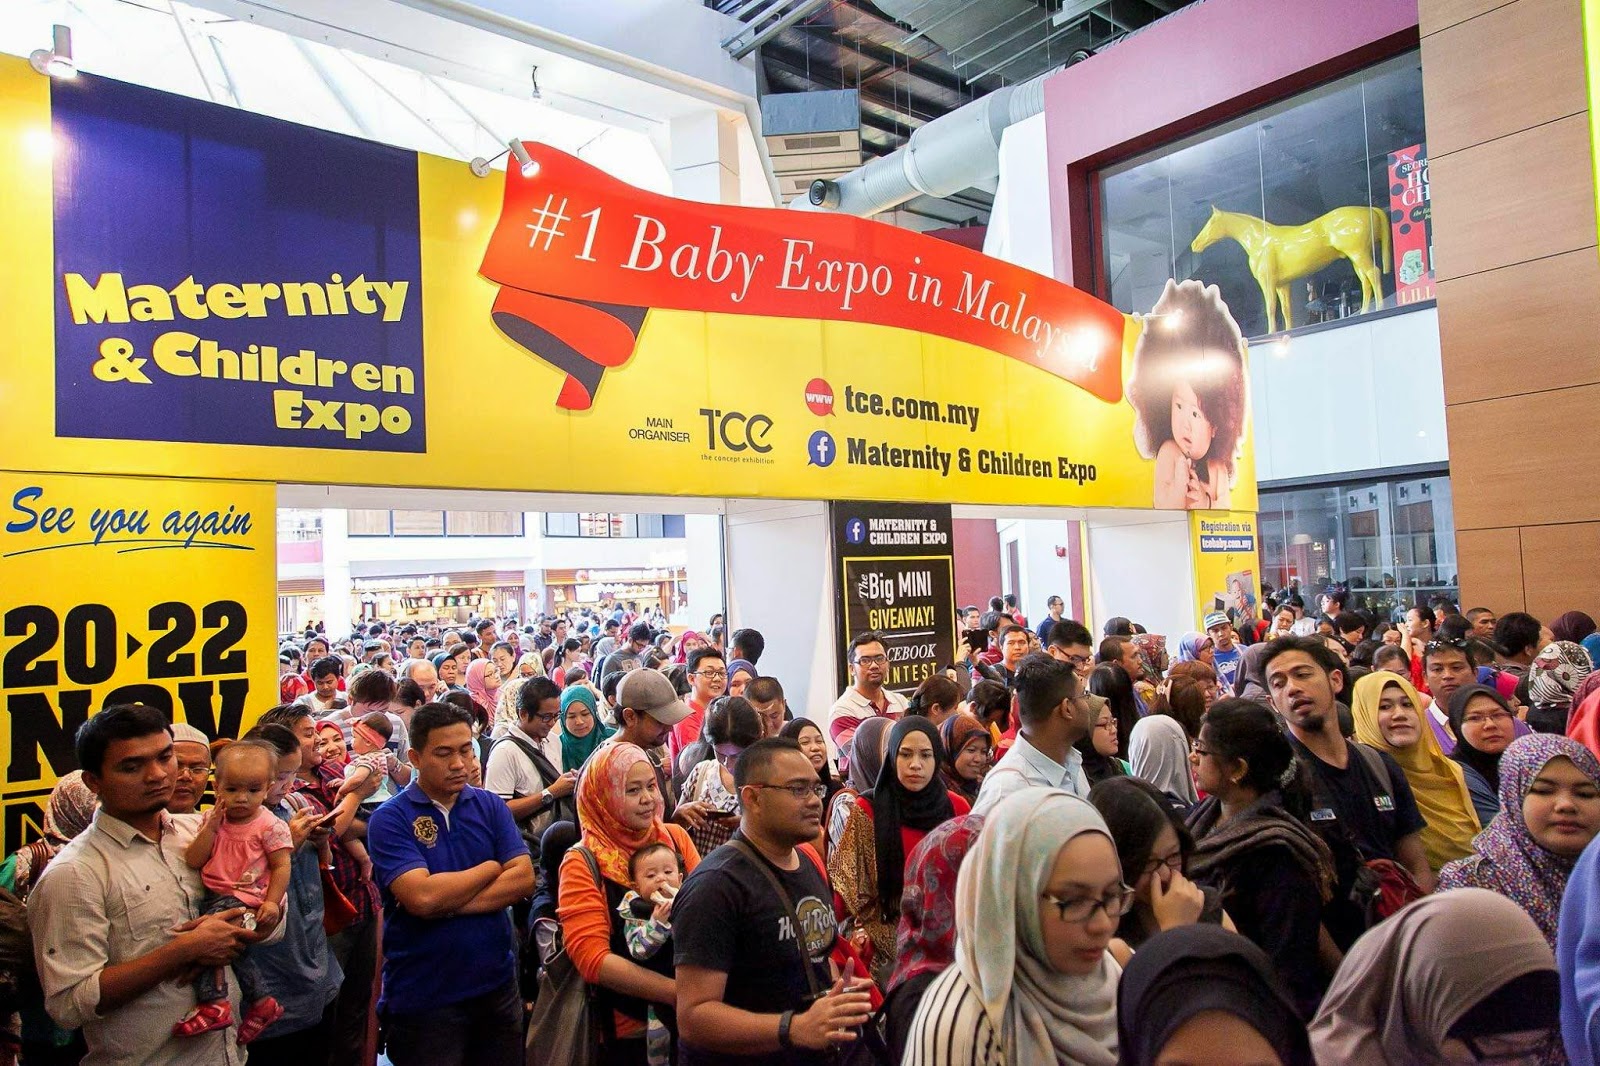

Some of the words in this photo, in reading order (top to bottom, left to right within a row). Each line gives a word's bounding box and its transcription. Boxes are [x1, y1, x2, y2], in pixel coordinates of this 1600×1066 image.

[526, 193, 602, 263] #1
[620, 213, 764, 303] Baby
[775, 238, 893, 311] Expo
[907, 256, 943, 308] in
[64, 272, 409, 325] Maternity
[92, 338, 154, 385] &
[152, 331, 415, 395] Children
[273, 389, 412, 439] Expo
[646, 417, 673, 429] MAIN
[806, 392, 833, 404] www
[845, 385, 979, 432] tce.com.my
[628, 428, 690, 443] ORGANISER
[714, 455, 740, 463] concept
[742, 457, 775, 465] exhibition
[847, 437, 951, 477] Maternity
[958, 447, 971, 472] &
[978, 449, 1053, 478] Children
[1057, 456, 1097, 486] Expo
[6, 486, 75, 534] See
[89, 508, 151, 546] you
[162, 504, 253, 549] again
[869, 518, 926, 532] MATERNITY
[930, 519, 937, 532] &
[1201, 520, 1240, 534] Registration
[1242, 522, 1251, 532] via
[869, 532, 920, 545] CHILDREN
[922, 532, 947, 545] EXPO
[858, 573, 869, 599] The
[869, 572, 894, 605] Big
[899, 571, 932, 599] MINI
[869, 606, 935, 631] GIVEAWAY!
[2, 603, 118, 689] 20
[147, 600, 248, 679] 22
[887, 643, 936, 662] CEBOOK
